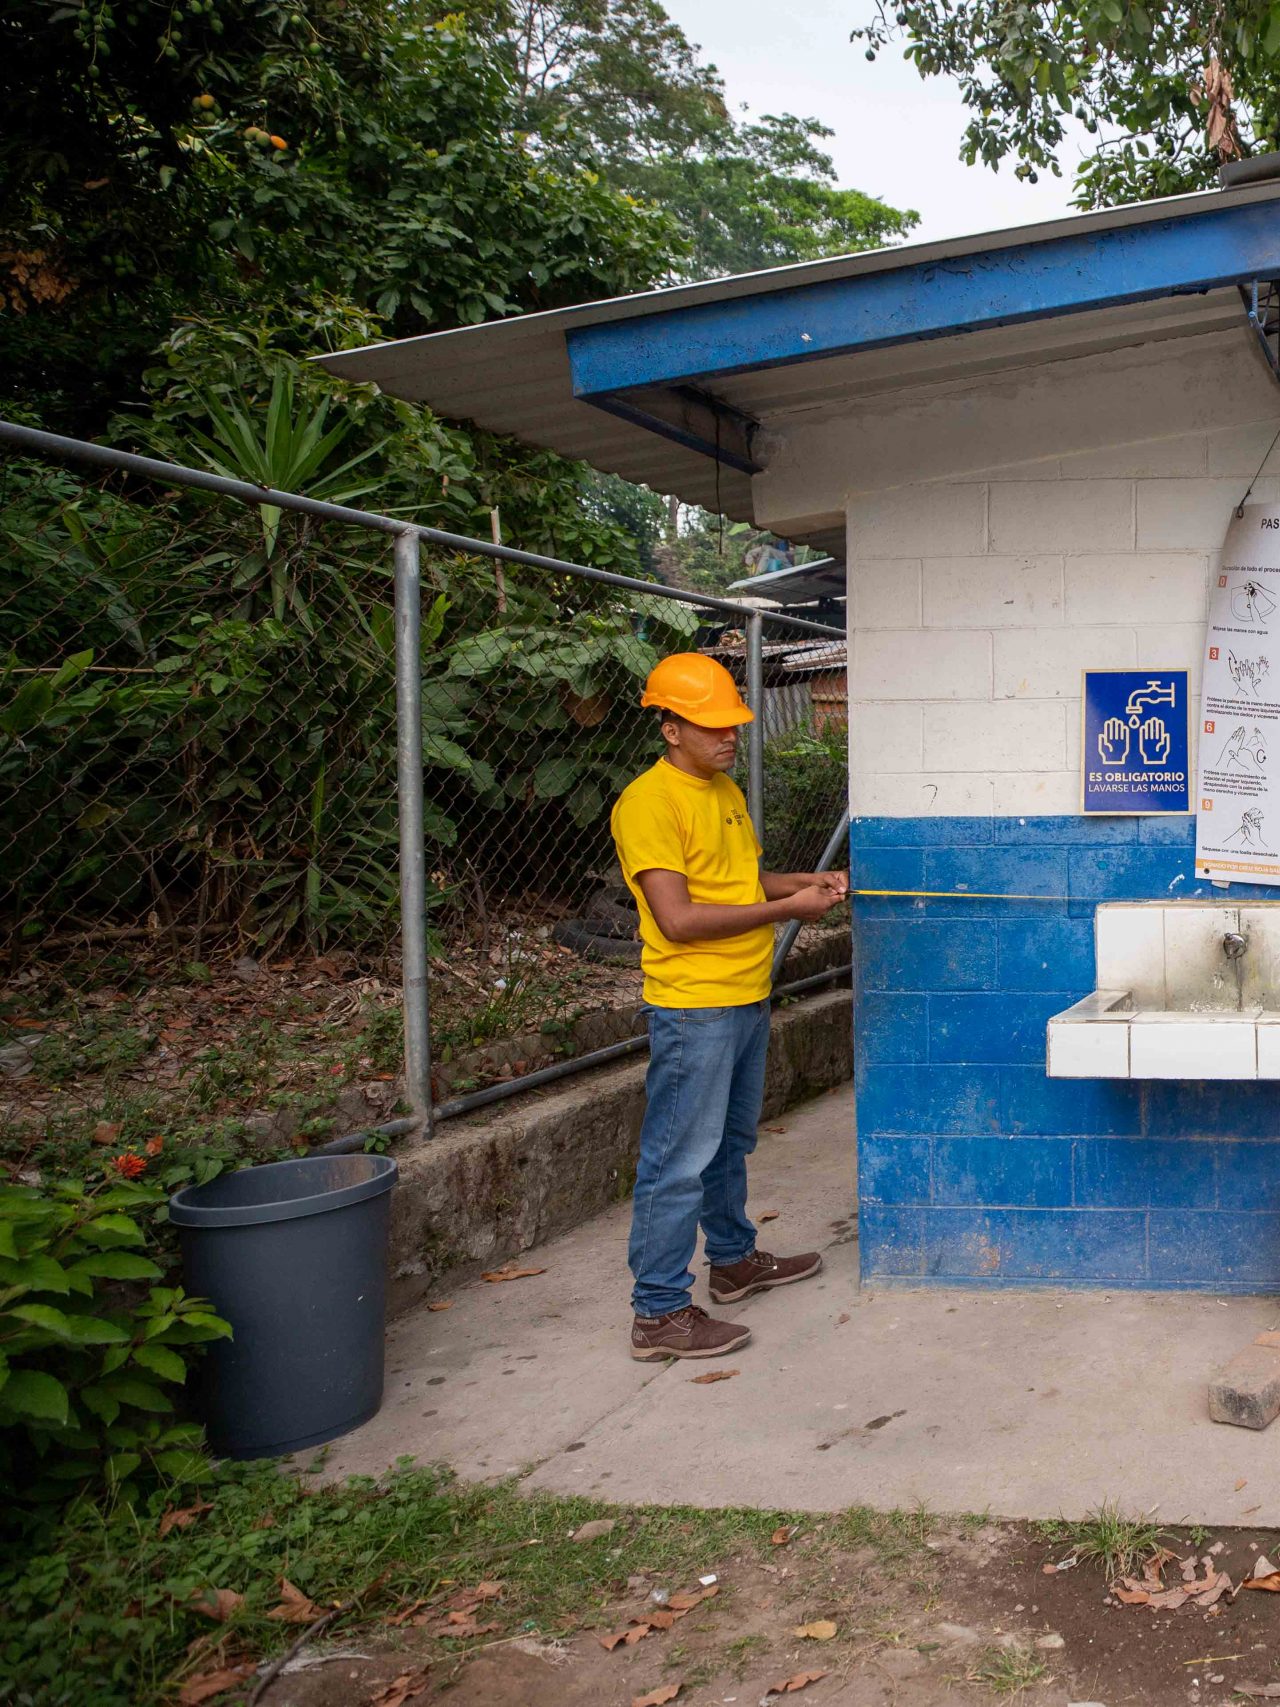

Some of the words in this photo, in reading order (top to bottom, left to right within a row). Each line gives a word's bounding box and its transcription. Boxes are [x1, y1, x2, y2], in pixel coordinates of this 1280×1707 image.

[1212, 649, 1216, 658] 3
[1207, 723, 1212, 731] 6
[1089, 772, 1102, 781] ES
[1105, 772, 1184, 782] OBLIGATORIO
[1132, 784, 1147, 792] LAS
[1151, 784, 1184, 792] MANOS
